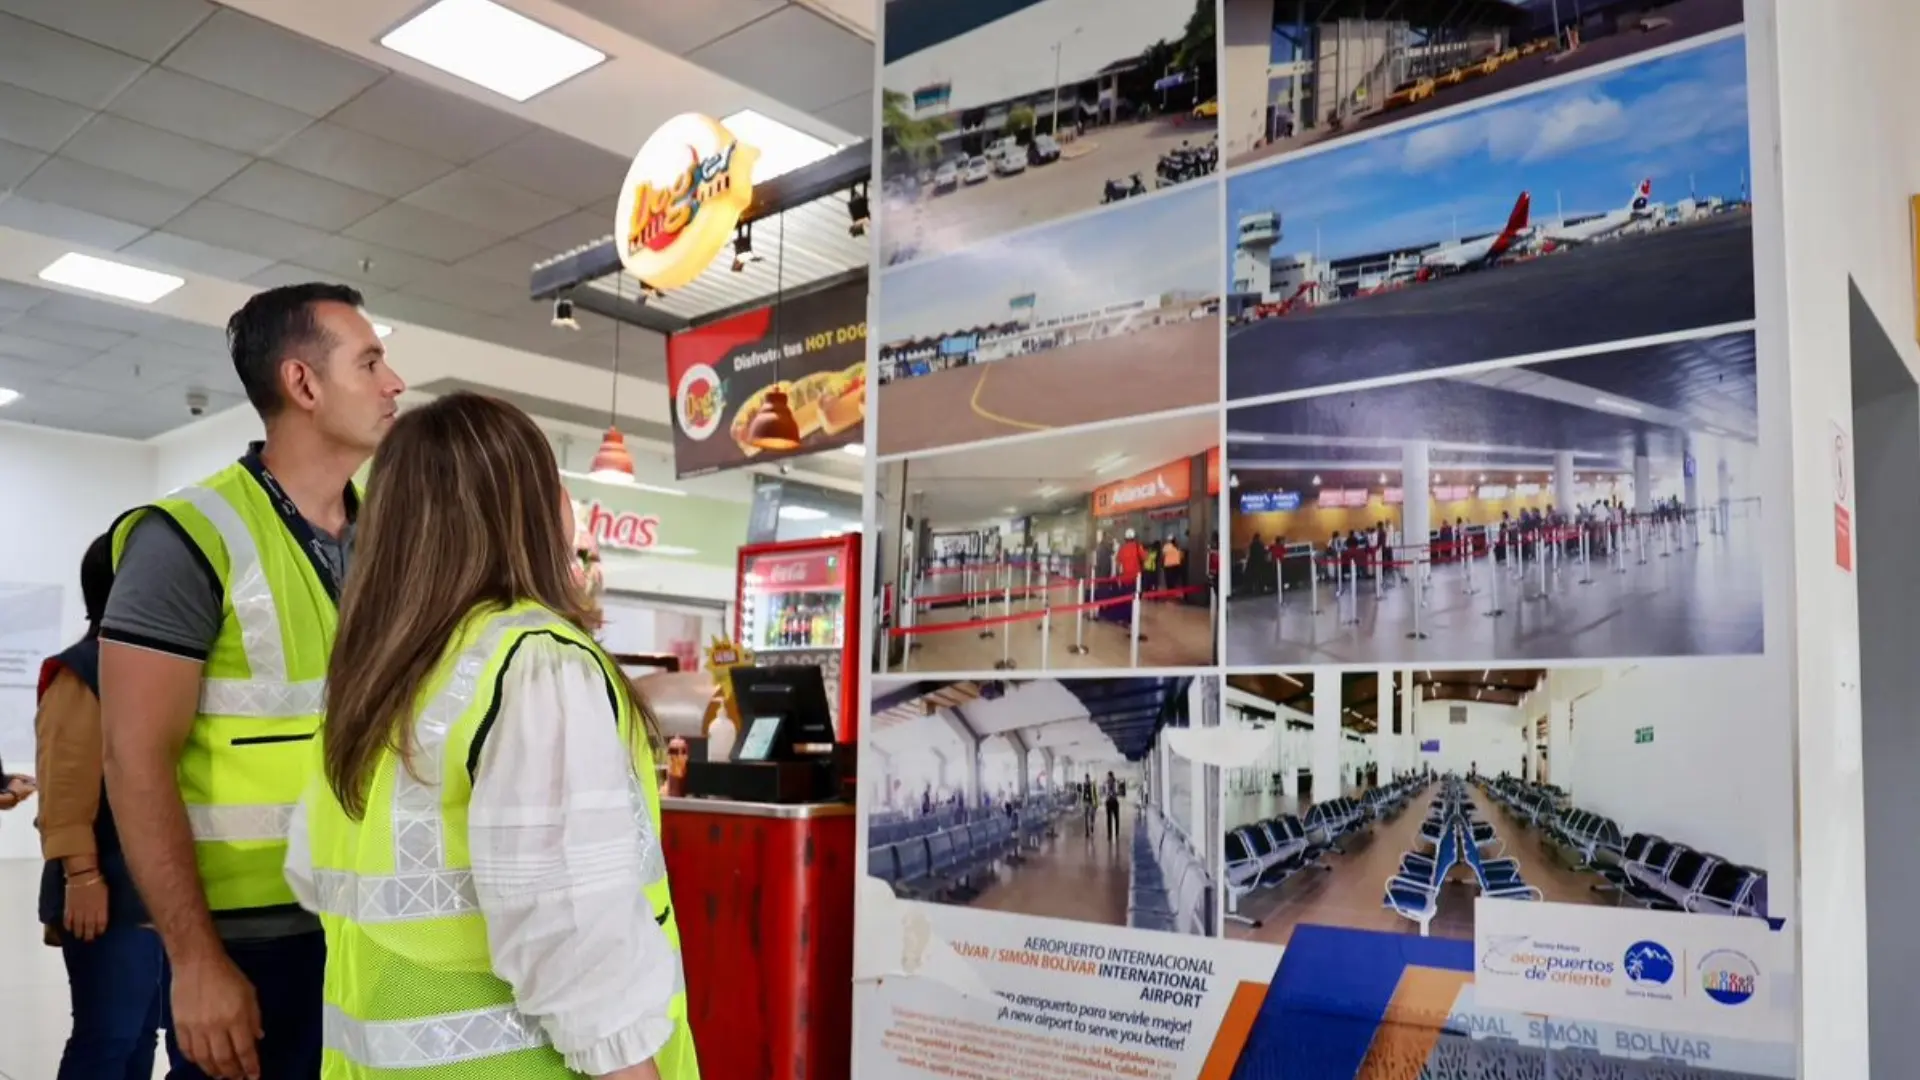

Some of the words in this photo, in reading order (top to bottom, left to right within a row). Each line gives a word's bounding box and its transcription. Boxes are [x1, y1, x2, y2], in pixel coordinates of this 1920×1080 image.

[783, 342, 803, 358] tus
[806, 329, 833, 352] HOT
[998, 948, 1039, 968] SIMÓN
[1041, 953, 1096, 976] BOLÍVAR
[1098, 962, 1209, 993] INTERNATIONAL
[1023, 936, 1105, 960] AEROPUERTO
[1107, 946, 1216, 976] INTERNACIONAL
[1511, 952, 1615, 974] aeropuertos
[1524, 965, 1547, 980] de
[1550, 970, 1612, 988] oriente
[1139, 985, 1203, 1009] AIRPORT
[1015, 994, 1078, 1015] aeropuerto
[1079, 1004, 1107, 1020] para
[1108, 1009, 1150, 1027] servirle
[1152, 1016, 1192, 1035] mejor!
[1010, 1009, 1034, 1024] new
[1035, 1011, 1073, 1031] airport
[1074, 1019, 1086, 1034] to
[1088, 1023, 1118, 1039] serve
[1119, 1029, 1143, 1045] you
[1144, 1030, 1186, 1051] better!
[1614, 1030, 1712, 1060] BOLÍVAR
